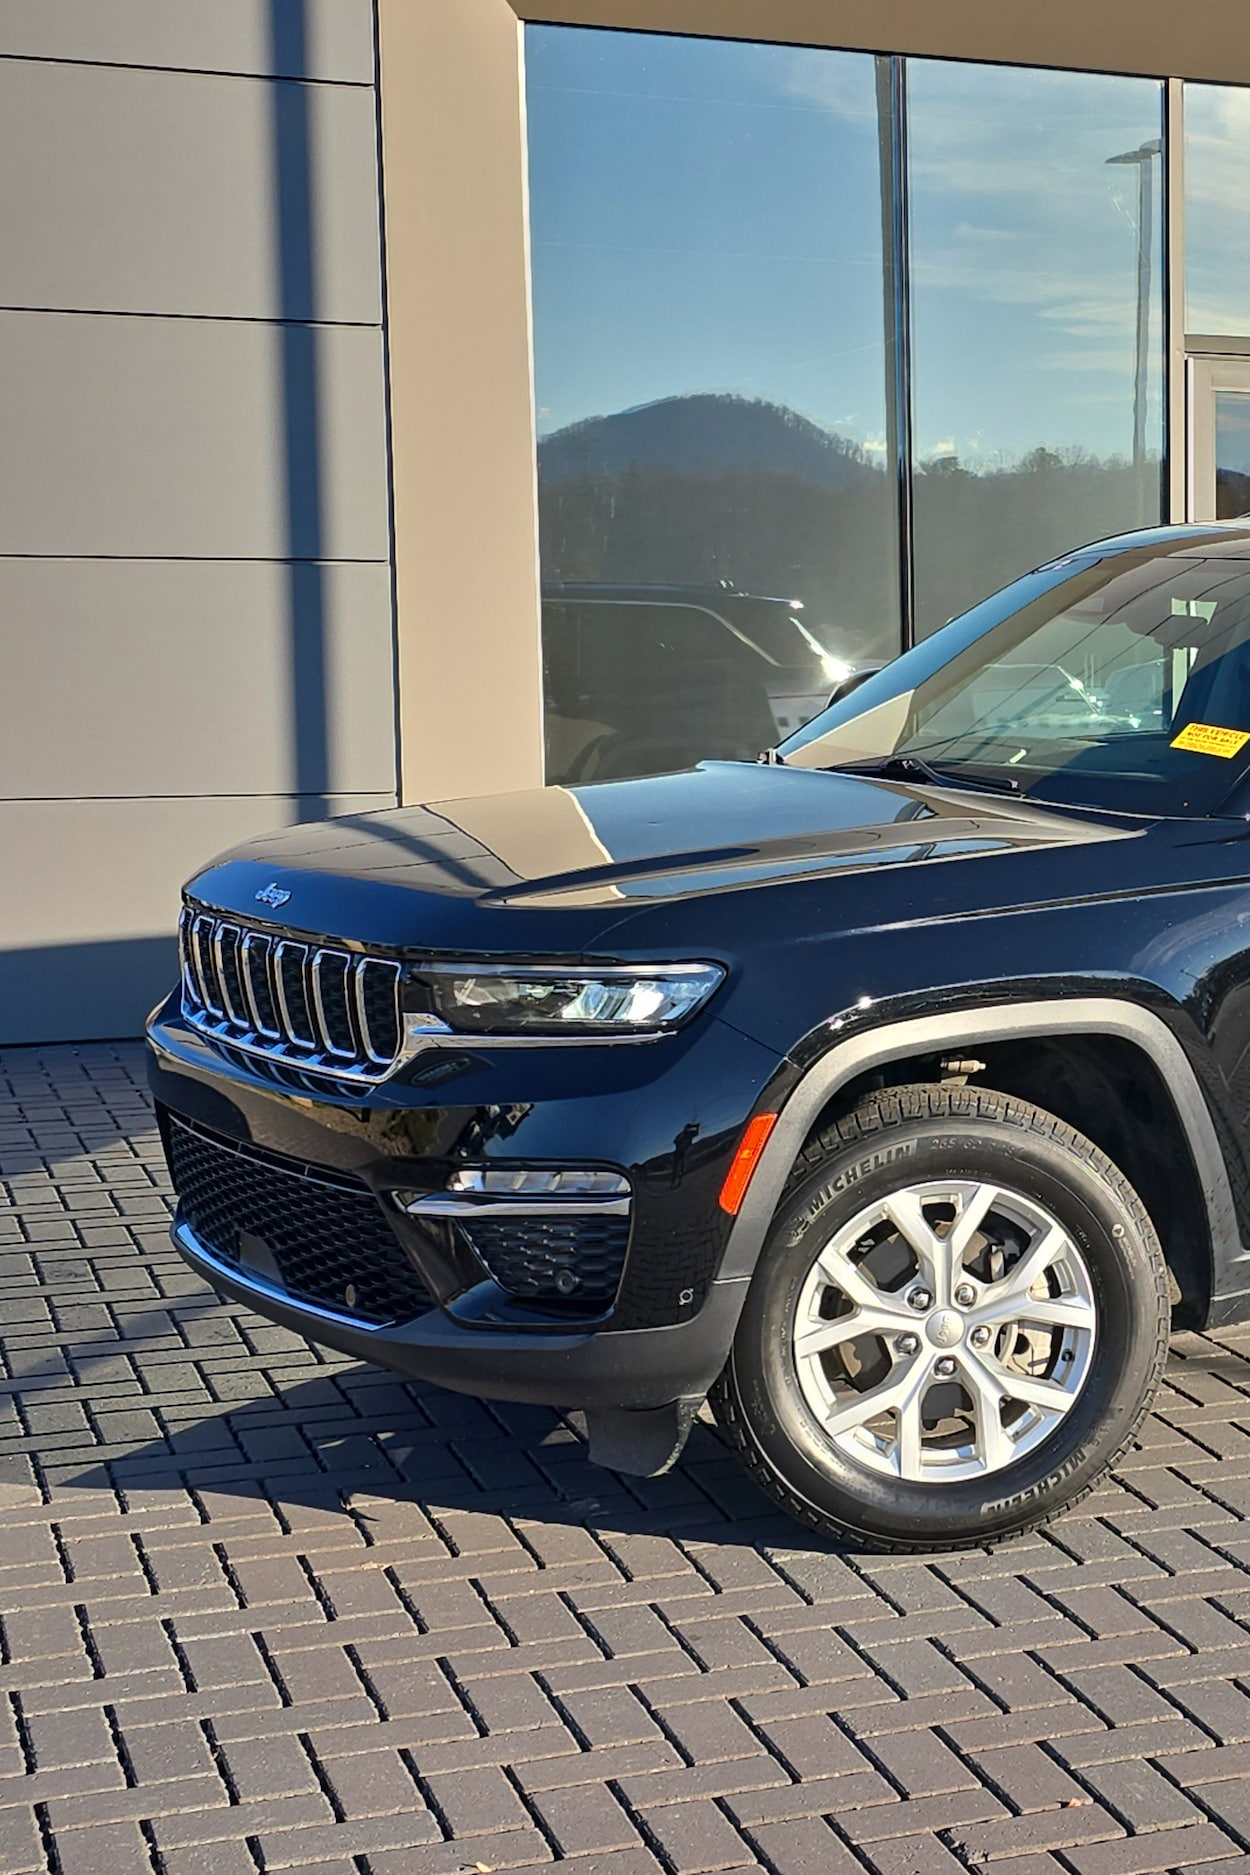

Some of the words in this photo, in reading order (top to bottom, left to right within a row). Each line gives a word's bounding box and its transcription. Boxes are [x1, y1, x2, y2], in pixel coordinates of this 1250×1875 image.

[1210, 728, 1247, 740] VEHICLE
[255, 882, 291, 909] Jeep
[807, 1143, 914, 1215] MICHELIN
[988, 1449, 1087, 1514] MICHELIN
